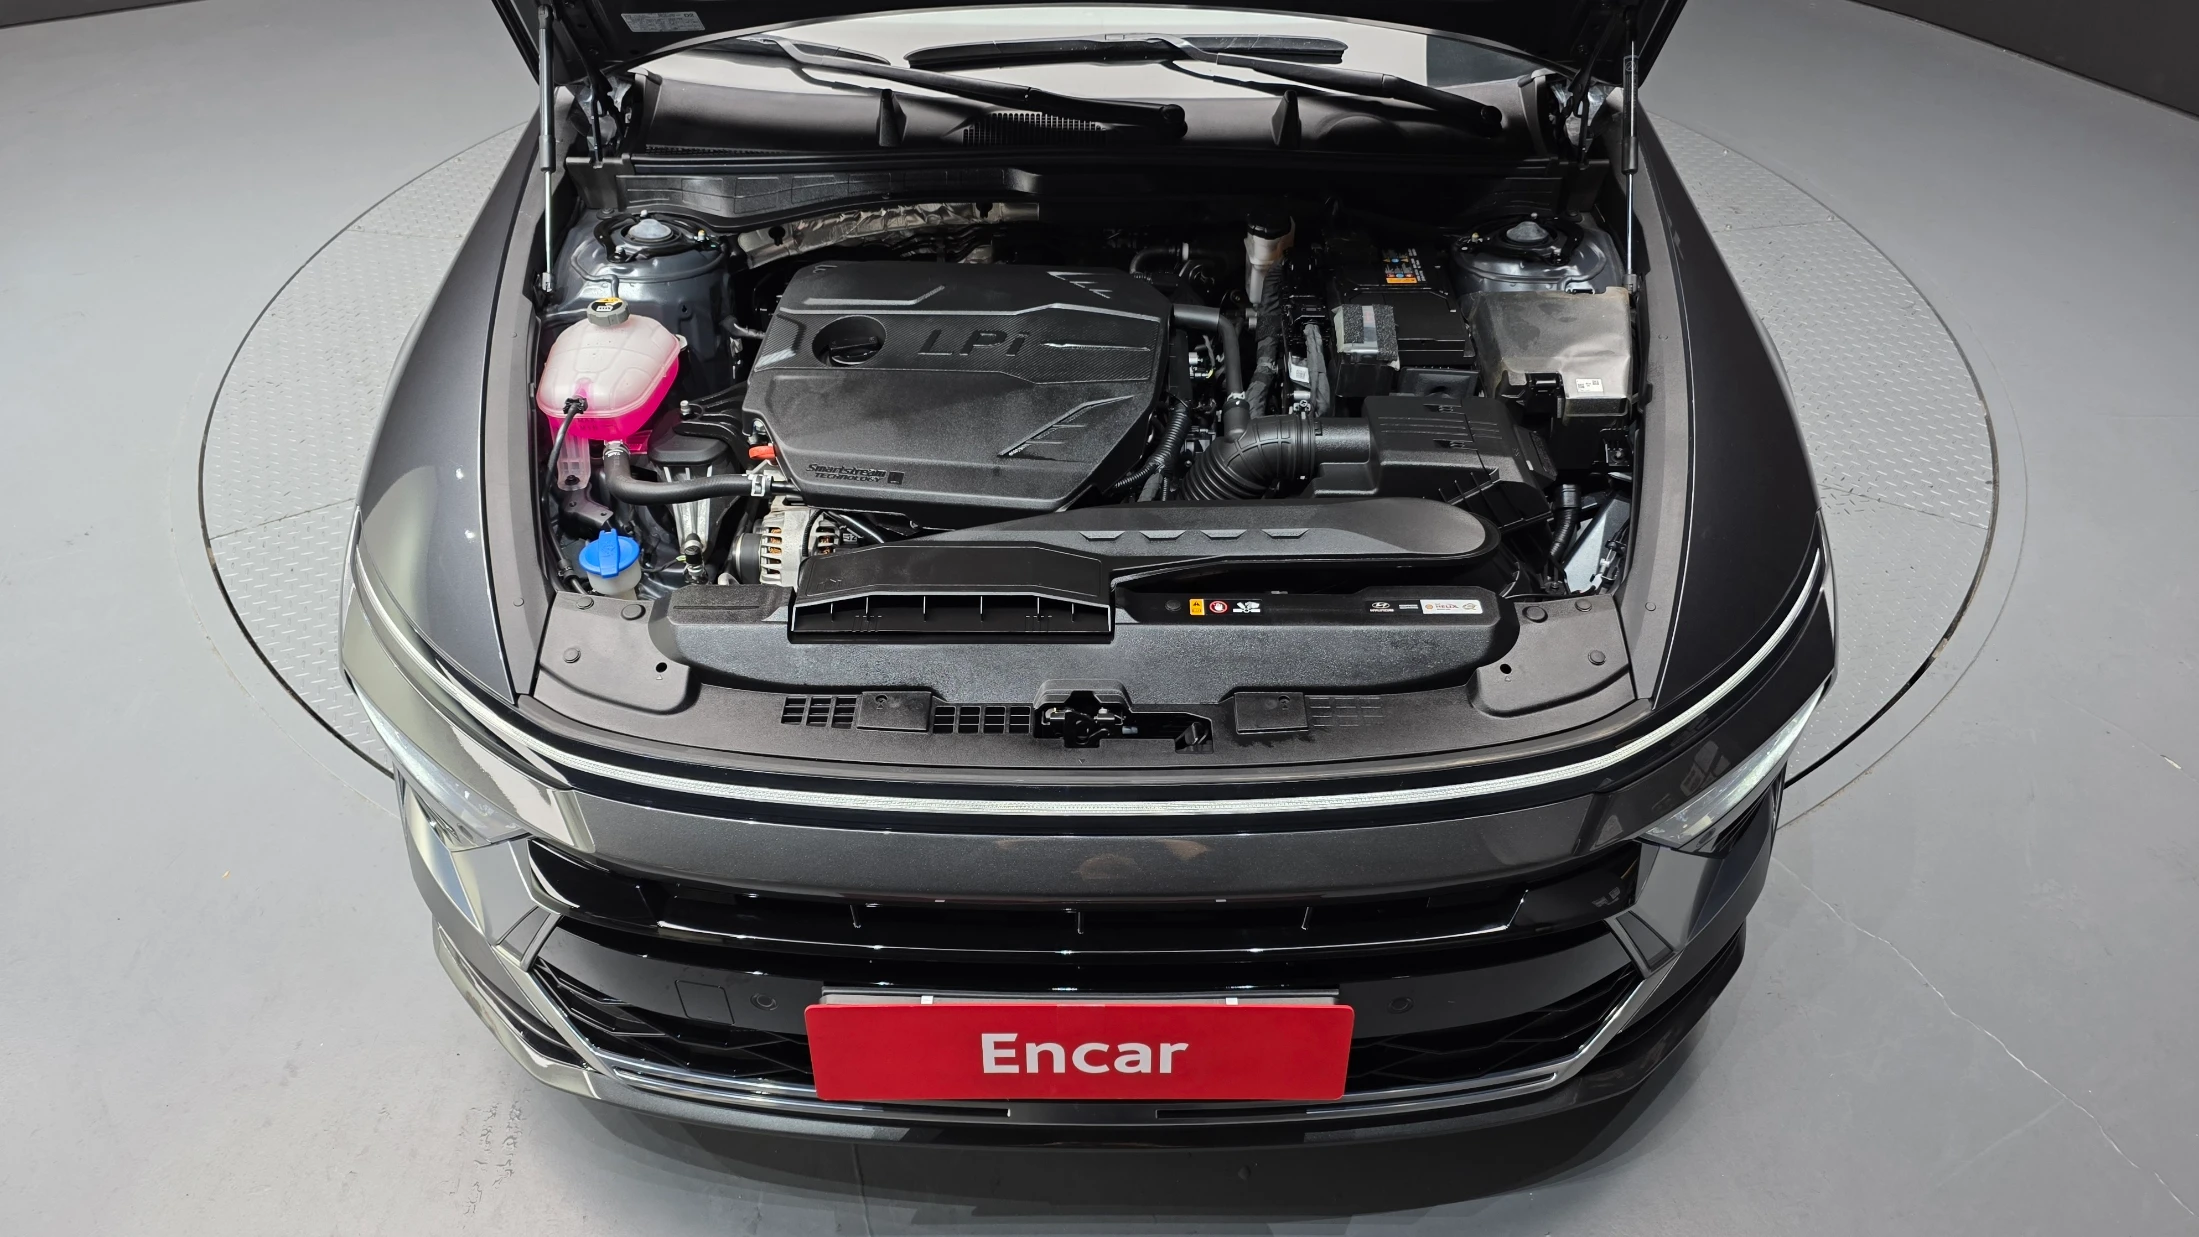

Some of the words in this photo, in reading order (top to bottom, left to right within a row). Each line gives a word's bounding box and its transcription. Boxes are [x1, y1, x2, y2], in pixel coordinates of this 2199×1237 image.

[918, 329, 1029, 356] LPi
[806, 463, 886, 477] Smartstream
[815, 472, 883, 482] TECHNOLOGY
[981, 1032, 1189, 1074] Encar
